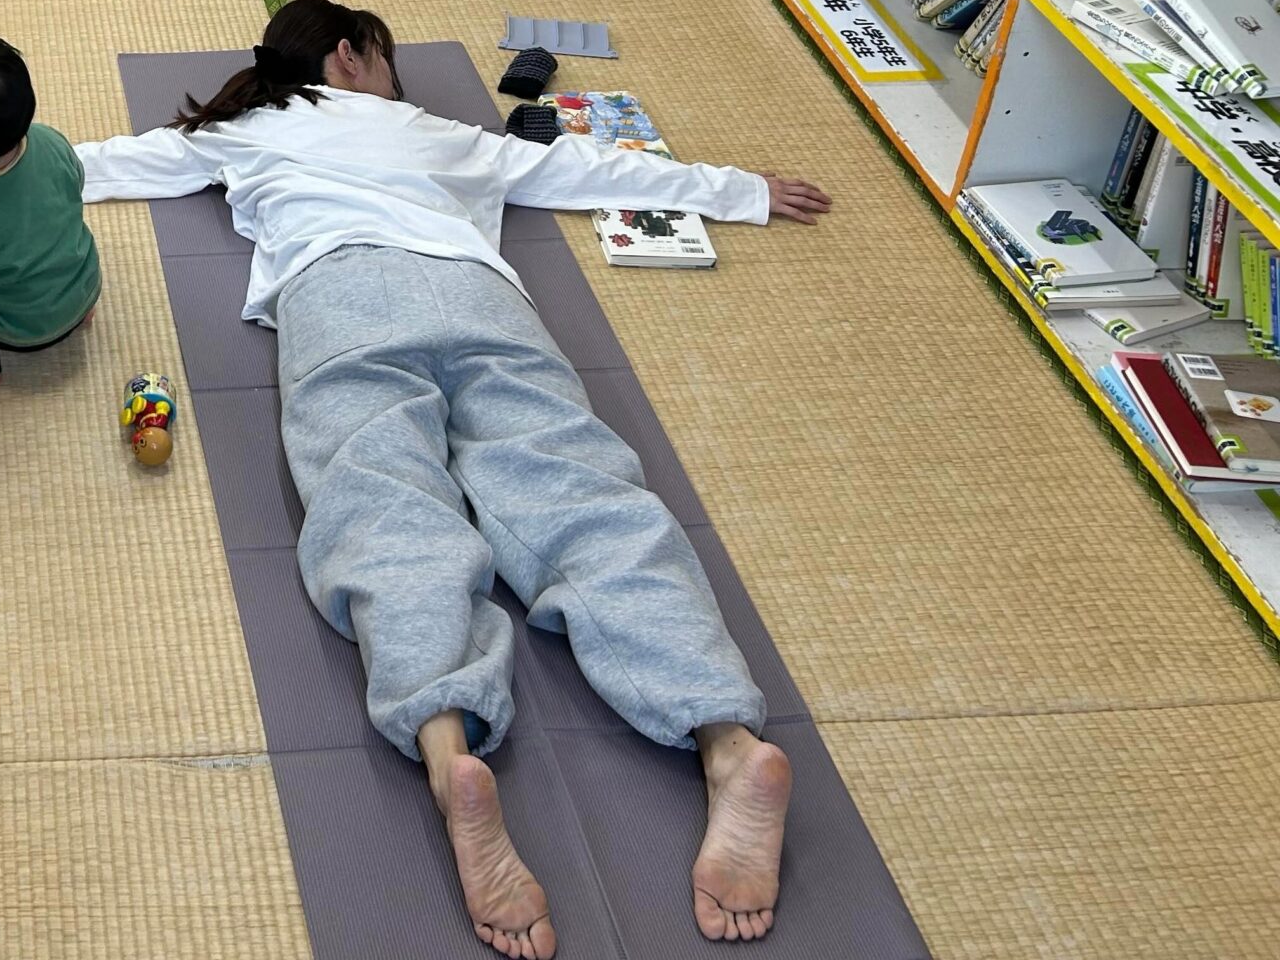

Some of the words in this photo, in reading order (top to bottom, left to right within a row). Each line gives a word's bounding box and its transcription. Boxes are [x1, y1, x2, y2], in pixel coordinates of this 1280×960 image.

[840, 29, 876, 58] 6年生
[852, 18, 907, 67] 小学5年生
